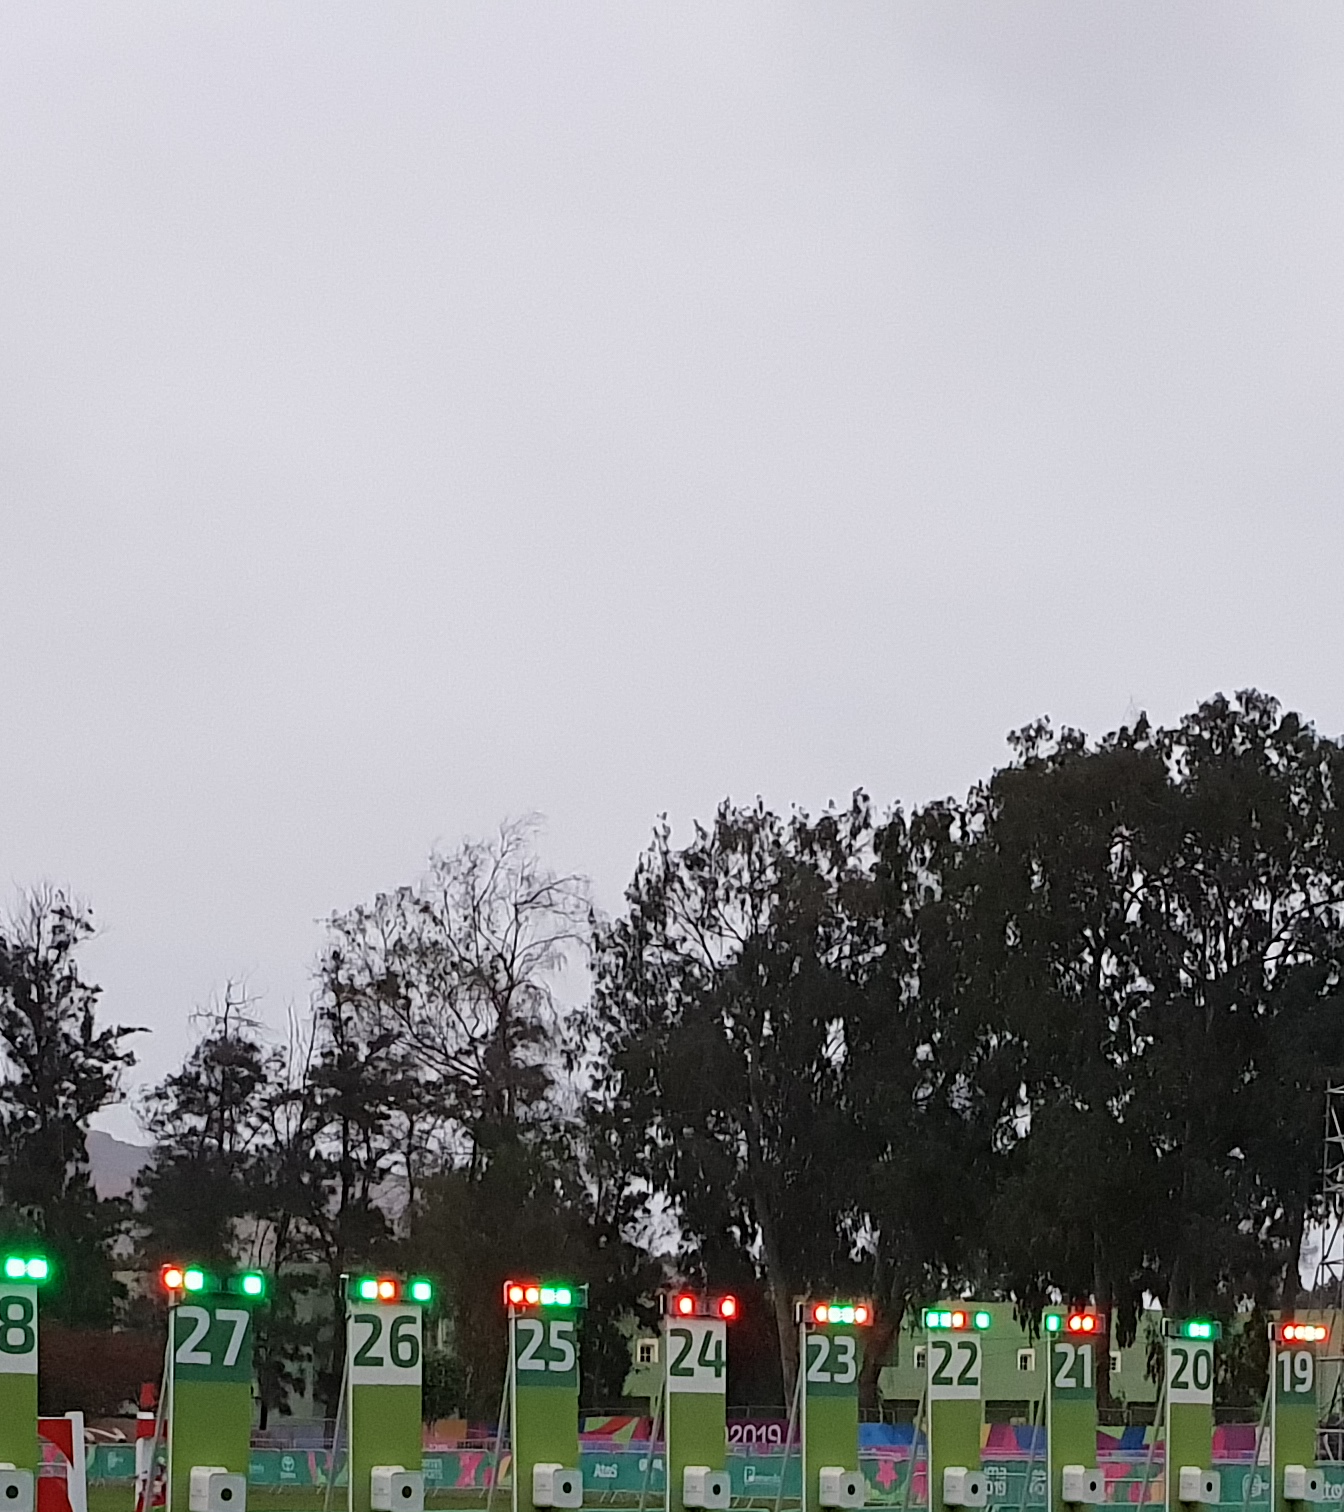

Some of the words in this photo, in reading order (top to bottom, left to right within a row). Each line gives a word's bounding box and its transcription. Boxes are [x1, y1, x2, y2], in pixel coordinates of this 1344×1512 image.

[175, 1307, 249, 1366] 27
[354, 1314, 419, 1369] 26
[517, 1320, 575, 1372] 25
[670, 1327, 726, 1378] 24
[807, 1335, 856, 1384] 23
[931, 1341, 979, 1386] 22
[1056, 1343, 1092, 1388] 21
[1171, 1348, 1212, 1390] 20
[1278, 1350, 1314, 1394] 19
[730, 1424, 782, 1444] 2019
